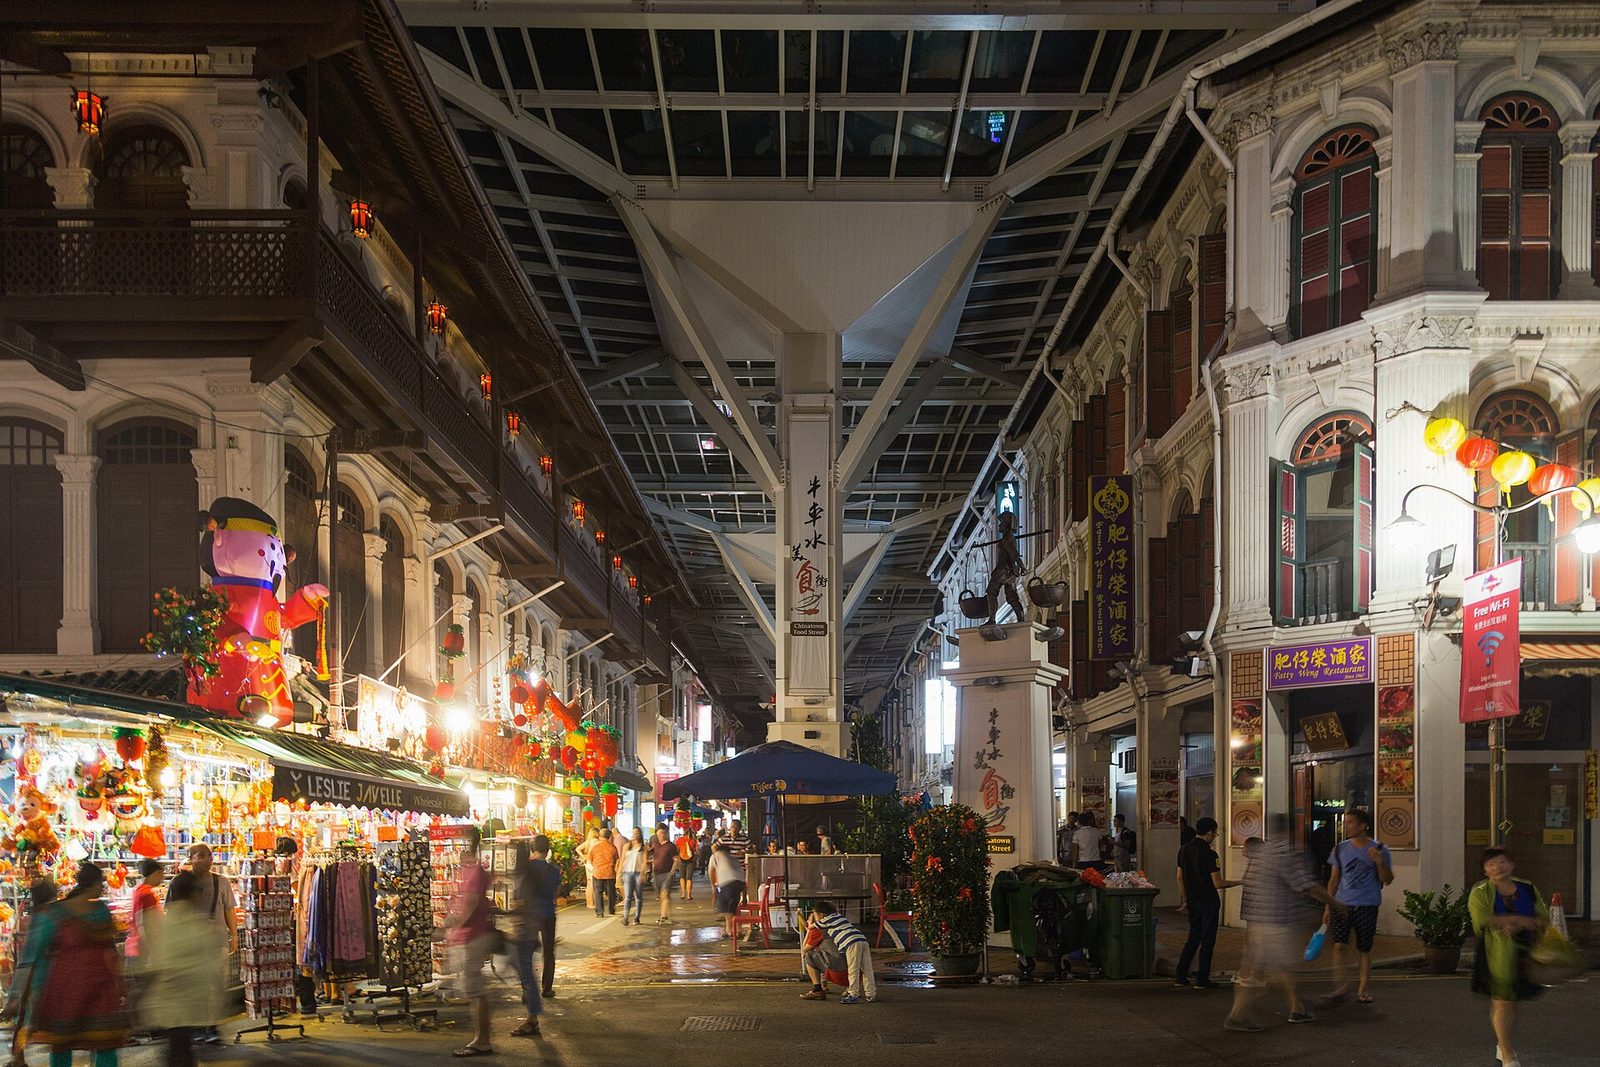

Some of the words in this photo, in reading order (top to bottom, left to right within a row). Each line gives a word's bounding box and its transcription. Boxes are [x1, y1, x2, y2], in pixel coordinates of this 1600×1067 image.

[1095, 521, 1105, 556] Fatty
[1094, 559, 1106, 588] Weng
[1107, 523, 1129, 646] 肥仔榮酒家
[1473, 606, 1488, 618] Free
[1489, 597, 1510, 612] Wi-Fi
[1096, 594, 1106, 655] Restaurant
[1274, 644, 1365, 671] 肥仔榮酒家
[1274, 671, 1294, 680] Fatty
[1299, 668, 1319, 678] Weng
[1323, 665, 1365, 676] Restaurant
[307, 775, 350, 800] LESLIE
[356, 783, 403, 807] JAVELLE
[413, 794, 442, 808] Wholesale
[751, 782, 774, 794] Tiger
